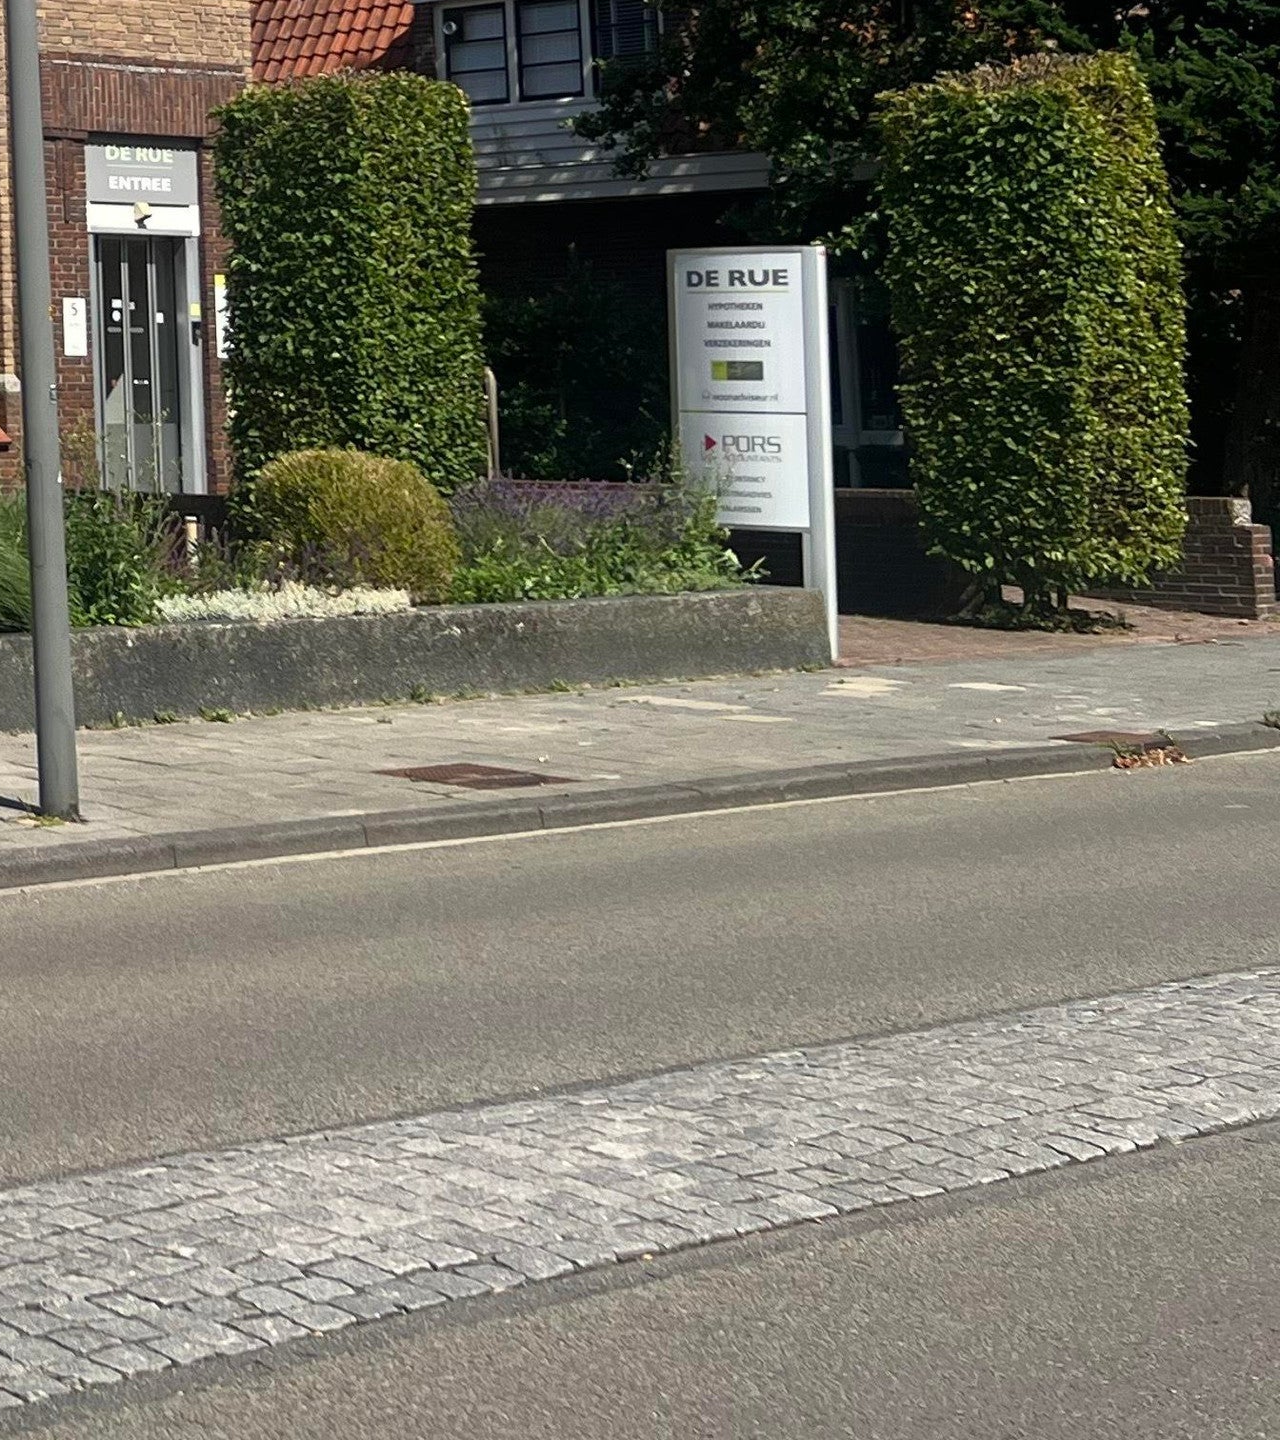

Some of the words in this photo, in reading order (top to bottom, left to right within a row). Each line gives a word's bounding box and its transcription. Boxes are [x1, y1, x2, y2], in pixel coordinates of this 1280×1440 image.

[105, 145, 132, 161] DE
[135, 147, 174, 163] RUE
[108, 175, 172, 192] ENTREE
[686, 270, 719, 288] DE
[728, 269, 789, 287] RUE
[71, 302, 78, 316] 5
[722, 434, 781, 454] PORS
